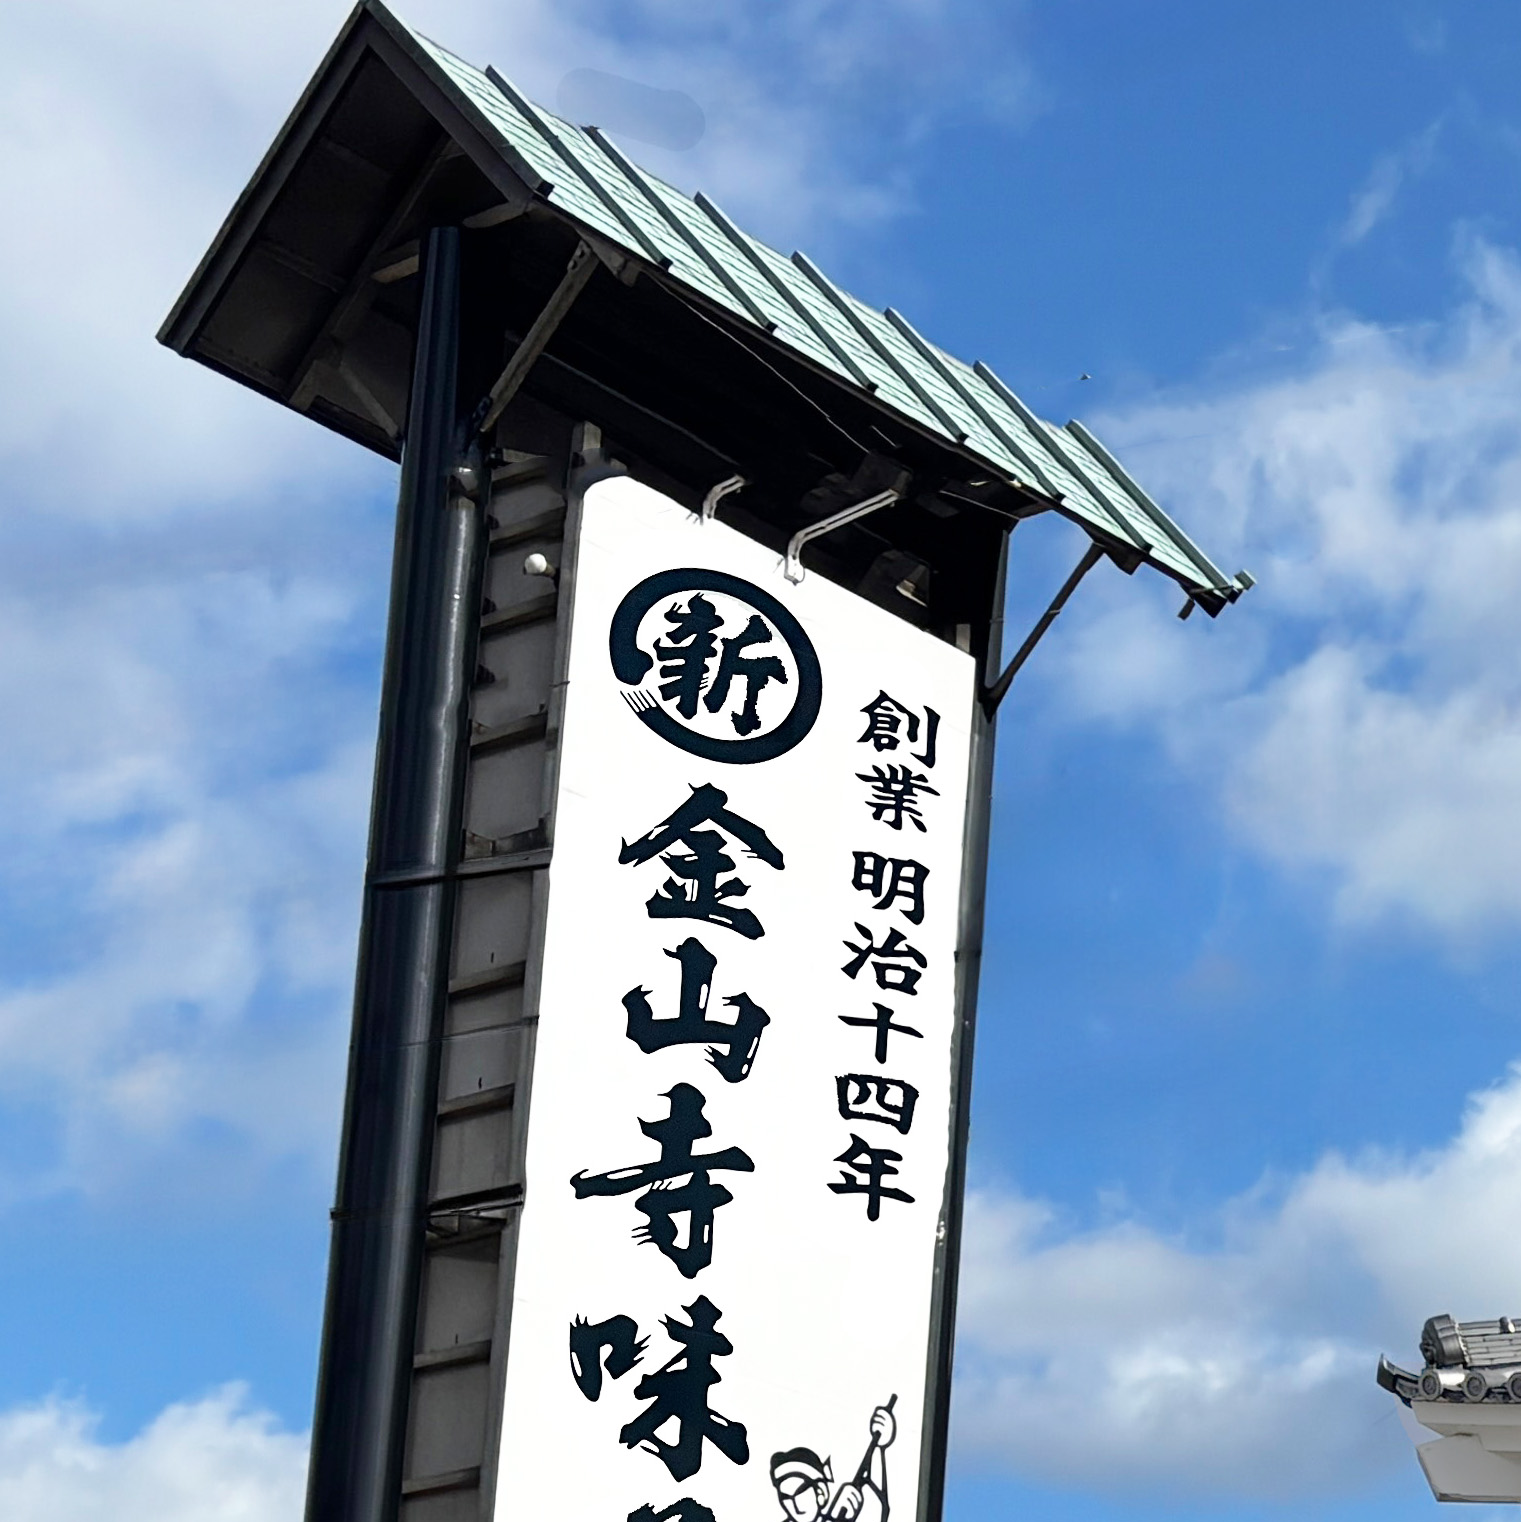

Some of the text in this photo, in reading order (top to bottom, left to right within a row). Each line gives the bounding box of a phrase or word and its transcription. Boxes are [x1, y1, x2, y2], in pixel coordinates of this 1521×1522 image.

[827, 690, 941, 1222] 創業明治十四年
